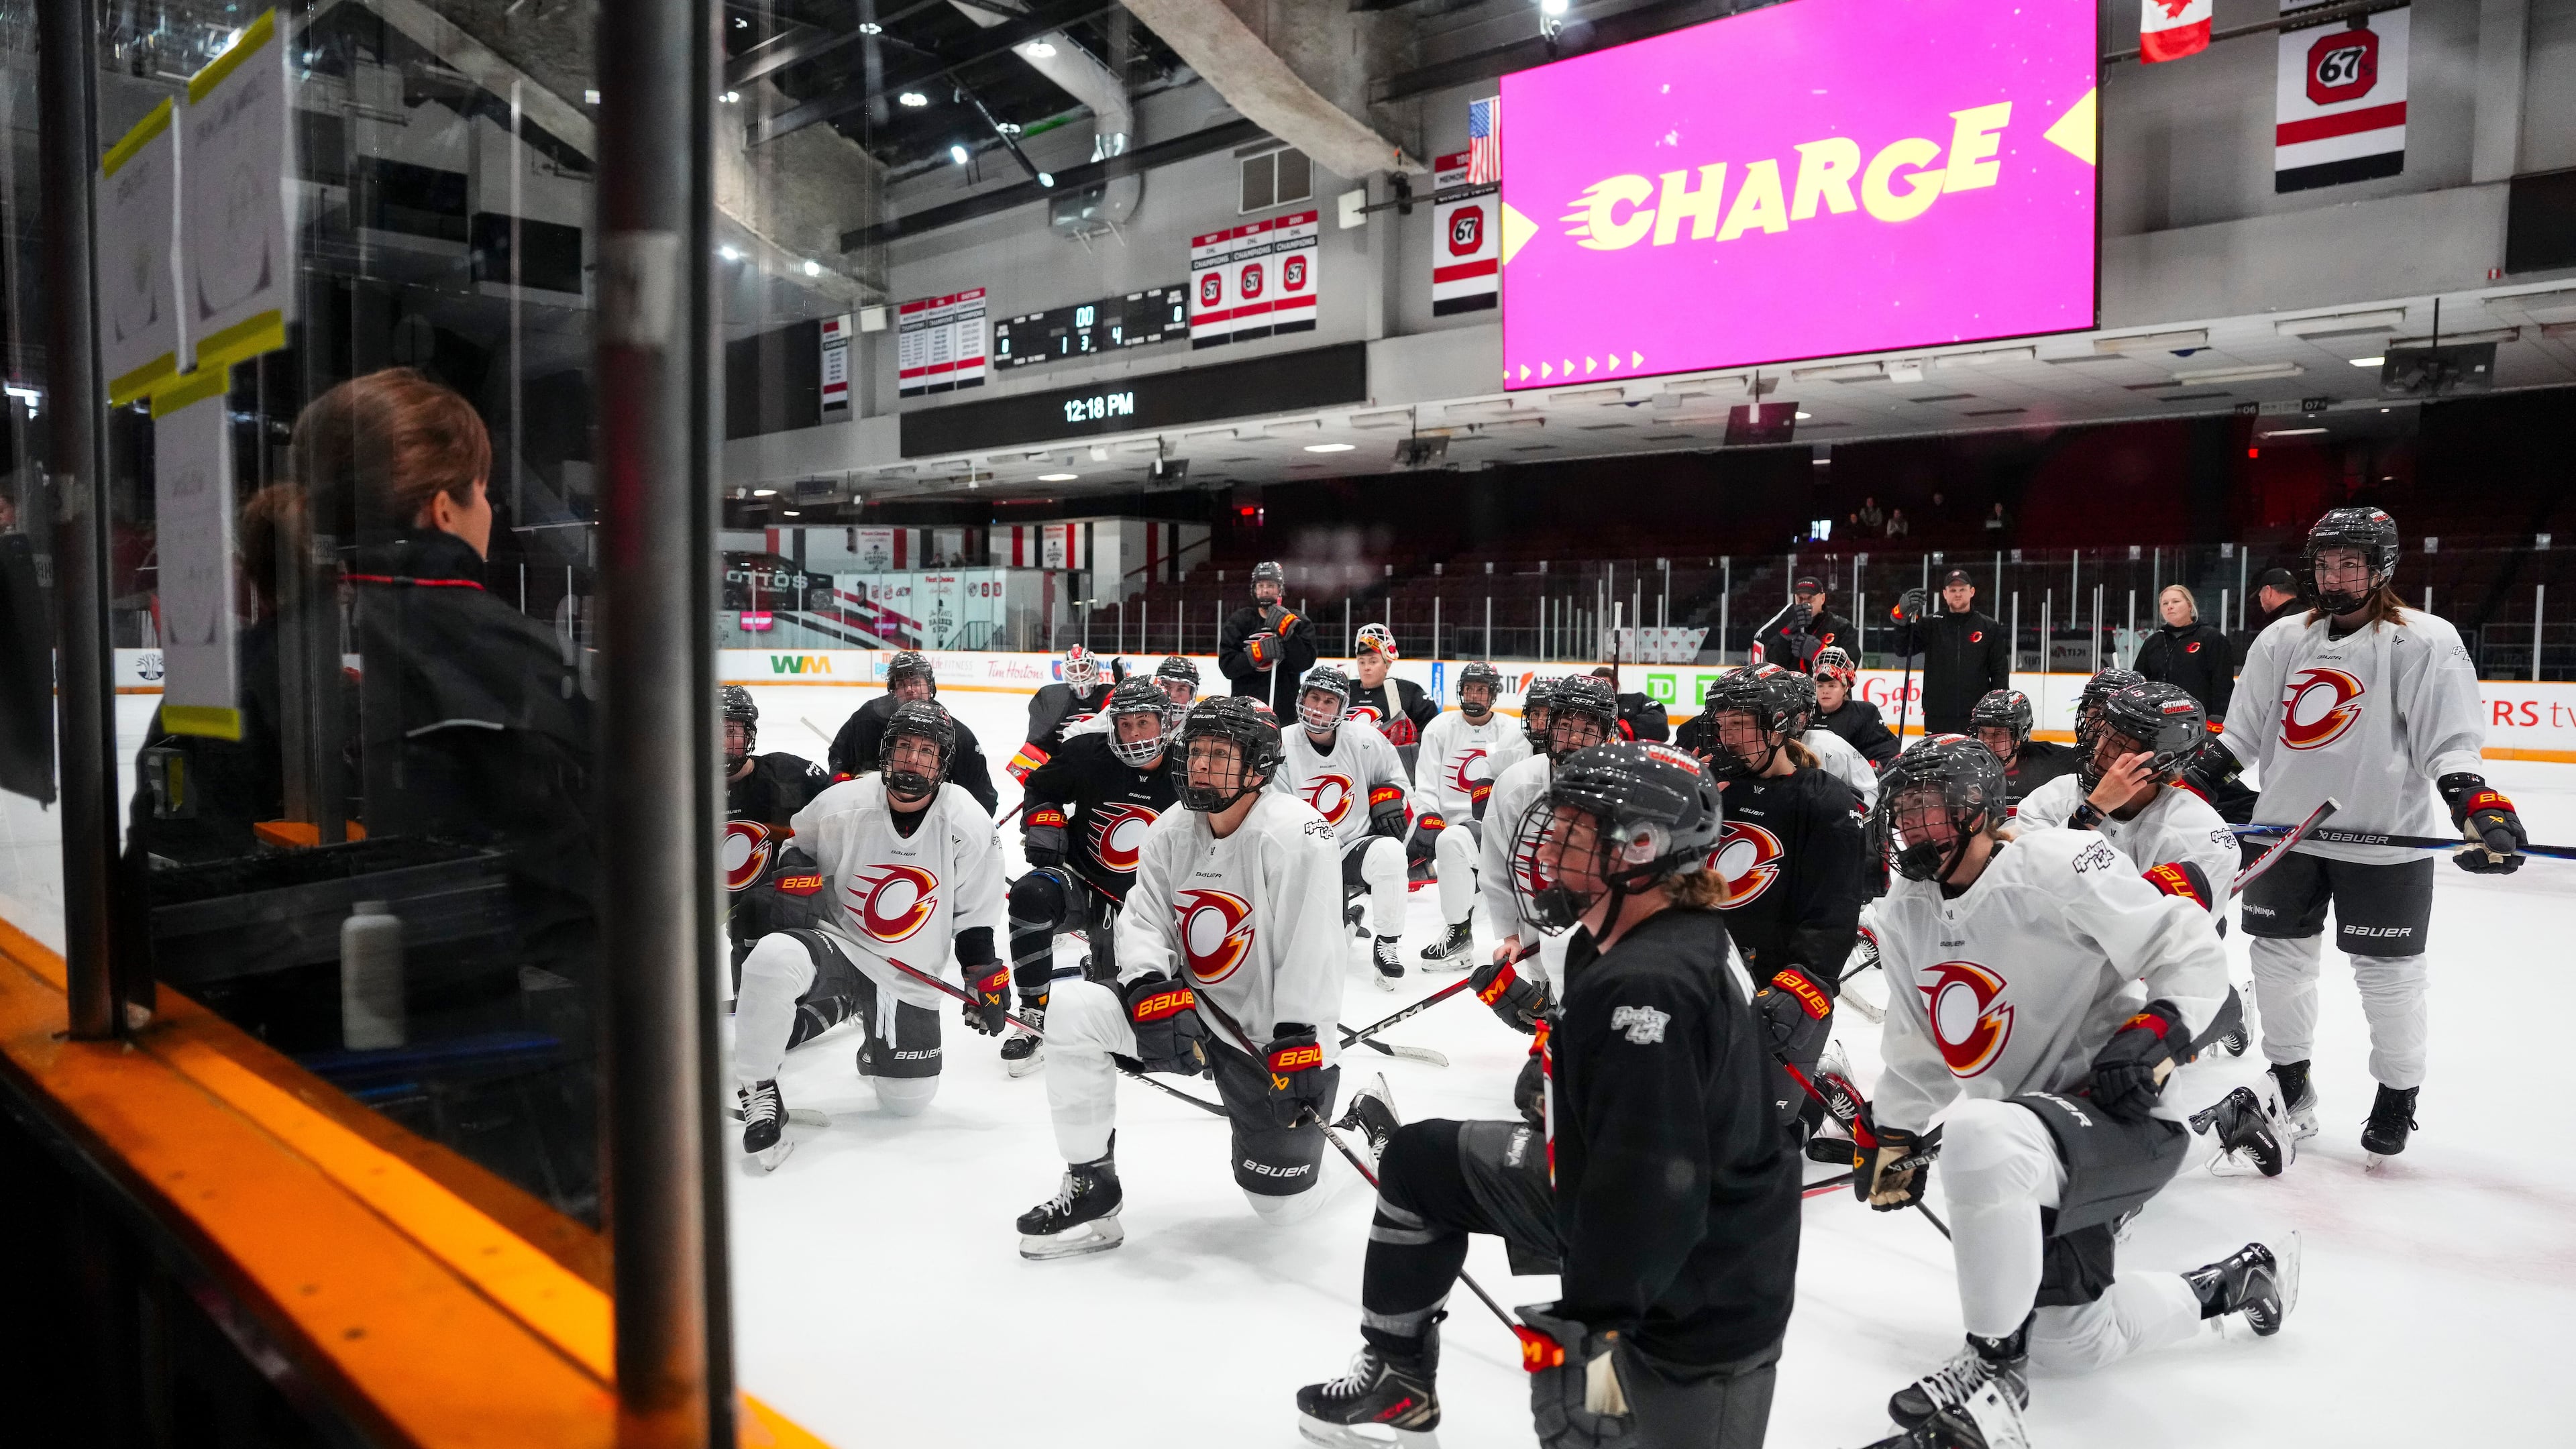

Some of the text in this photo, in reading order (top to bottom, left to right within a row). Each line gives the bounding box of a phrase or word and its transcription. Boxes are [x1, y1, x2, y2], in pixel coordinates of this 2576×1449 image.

[1559, 101, 2012, 251] CHARGE
[1276, 237, 1316, 252] CHAMPIONS
[1065, 393, 1134, 422] 12:18 PM
[987, 661, 1044, 680] Tim Hortons
[1650, 678, 1674, 699] TD
[1571, 696, 1596, 705] CCM
[2162, 699, 2191, 709] OTTAWA
[909, 716, 933, 724] BAUER
[2491, 701, 2538, 727] RS
[1128, 792, 1151, 800] BAUER
[1739, 807, 1764, 817] BAUER
[2330, 832, 2389, 845] BAUER
[2072, 840, 2108, 873] Hockey
[2255, 906, 2275, 916] NINJA
[2344, 924, 2411, 938] BAUER
[1772, 971, 1830, 1018] BAUER
[1354, 1003, 1424, 1042] CCM
[1318, 1120, 1346, 1150] BAUER
[2256, 1130, 2274, 1149] BAUER
[1242, 1159, 1311, 1177] BAUER
